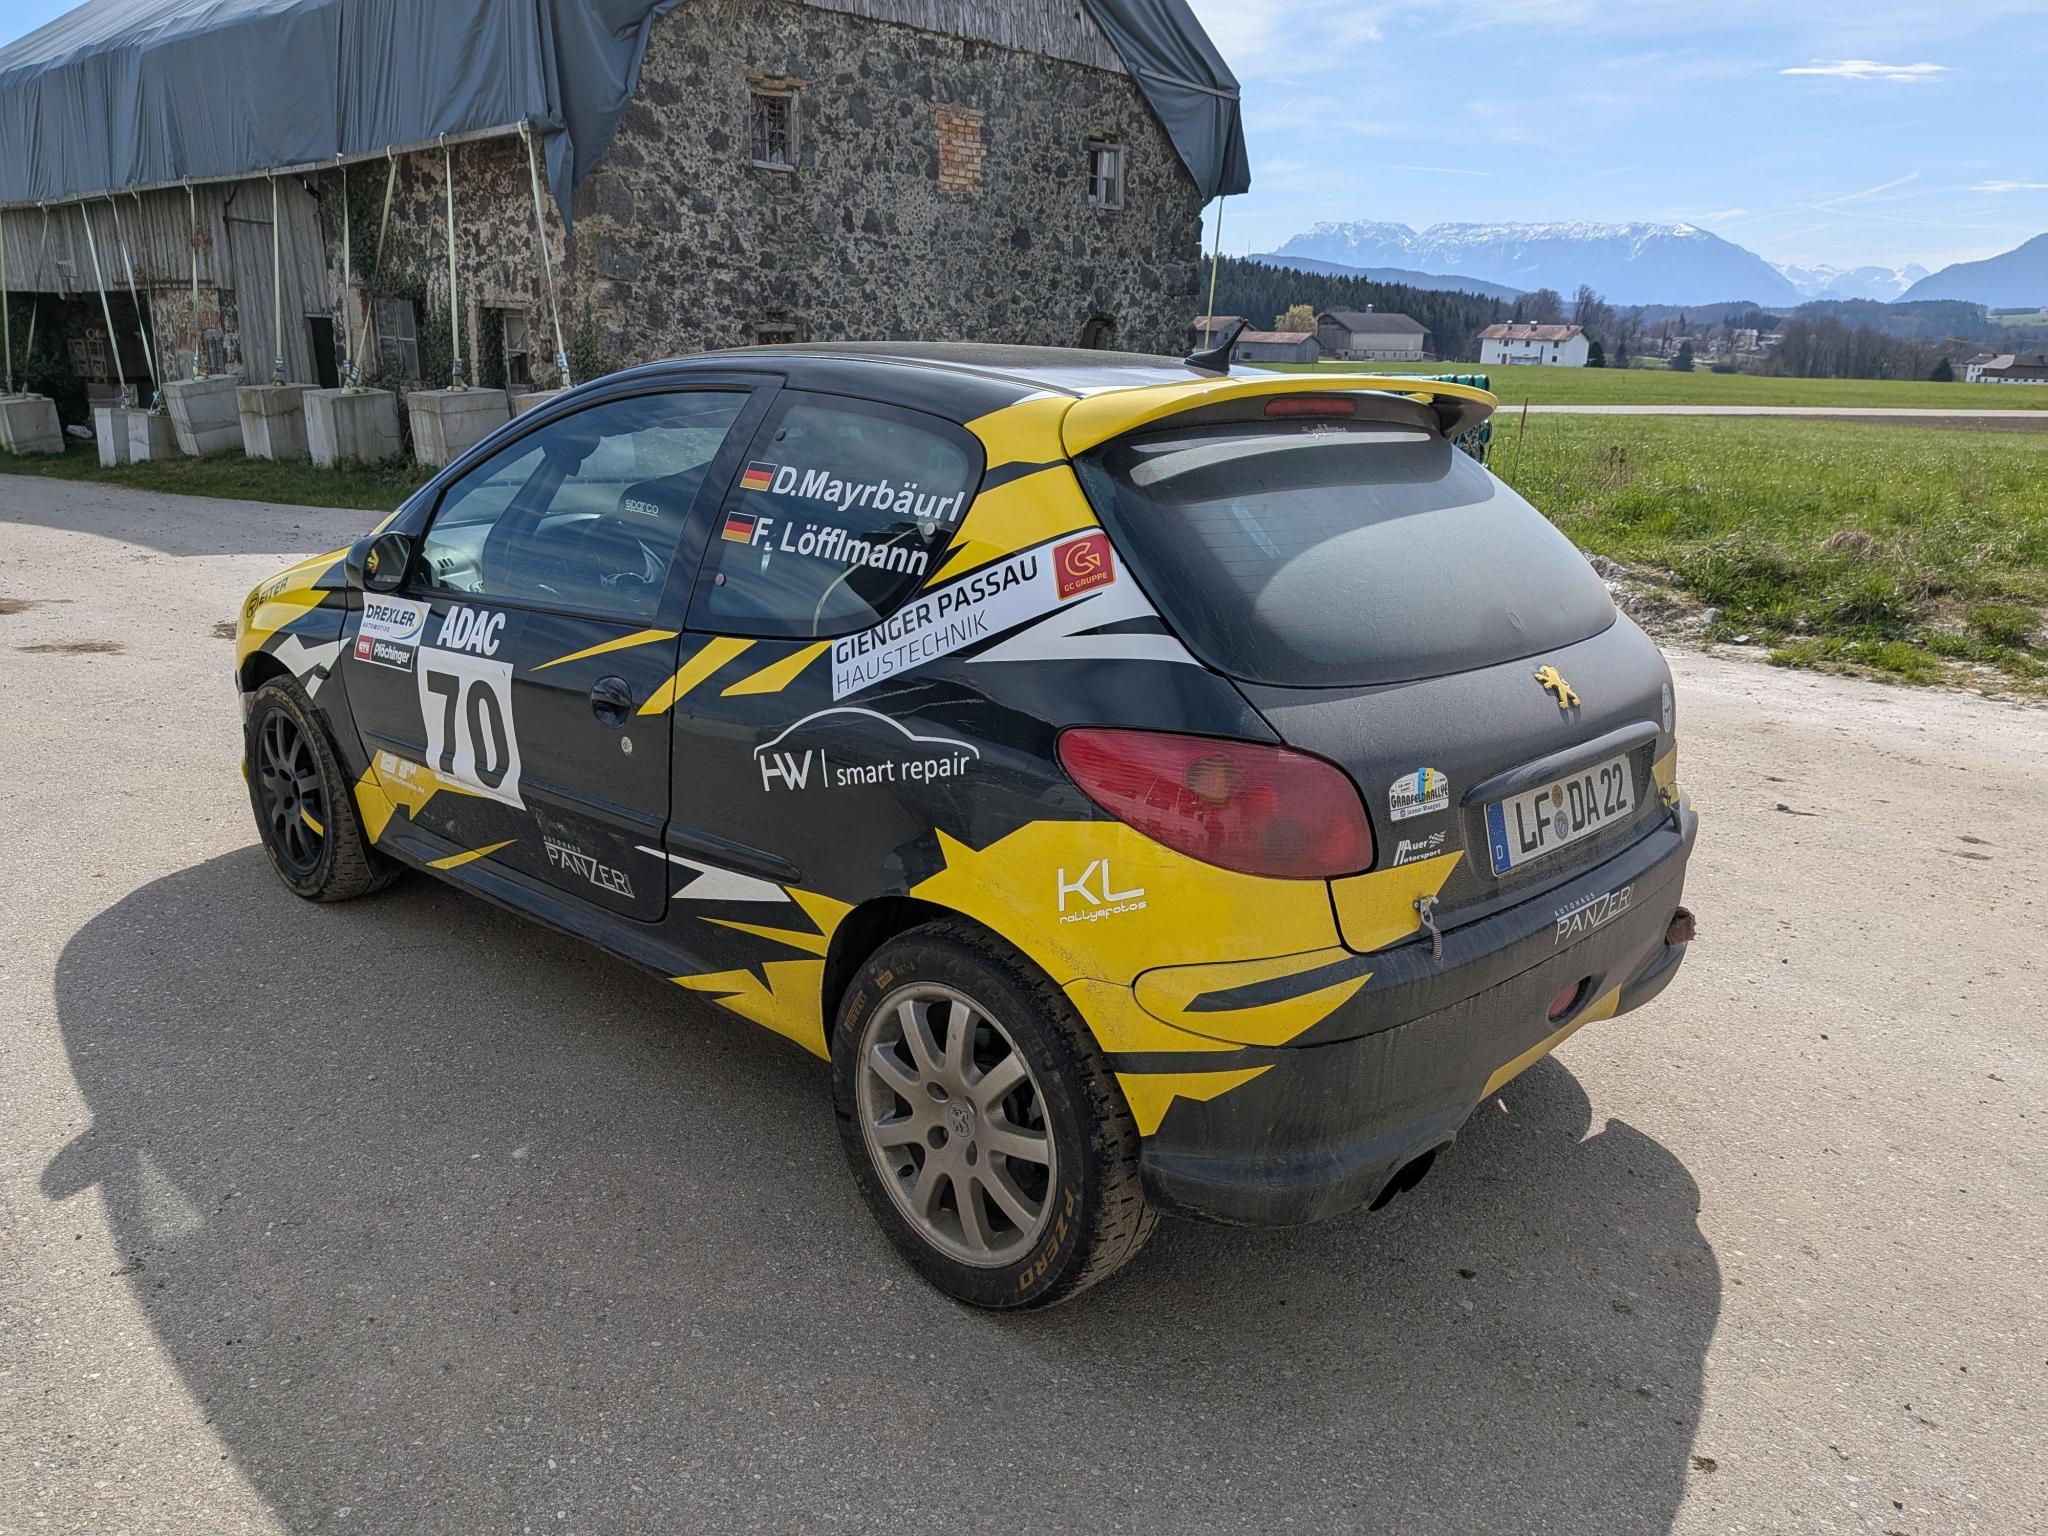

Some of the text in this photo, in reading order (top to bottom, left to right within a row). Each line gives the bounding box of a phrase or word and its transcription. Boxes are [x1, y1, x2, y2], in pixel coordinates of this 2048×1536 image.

[772, 466, 965, 522] D.Mayrbäurl
[780, 522, 928, 576] Löfflmann
[1064, 571, 1108, 592] GC GRUPPE
[362, 621, 391, 633] AUTOMOTIVE
[366, 604, 416, 627] DREXLER
[436, 605, 506, 656] ADAC
[836, 555, 1038, 664] GIENGER PASSAU
[837, 609, 989, 694] HAUSTECHNIK
[427, 669, 510, 789] 70
[836, 760, 895, 786] smart
[902, 751, 970, 784] repair
[1496, 763, 1627, 860] D LF DA 22
[543, 834, 581, 853] AUTOHAUS
[544, 841, 635, 899] PANZER
[1058, 858, 1145, 912] KL
[1554, 892, 1595, 918] AUTOHAUS
[1554, 886, 1631, 946] PANZER
